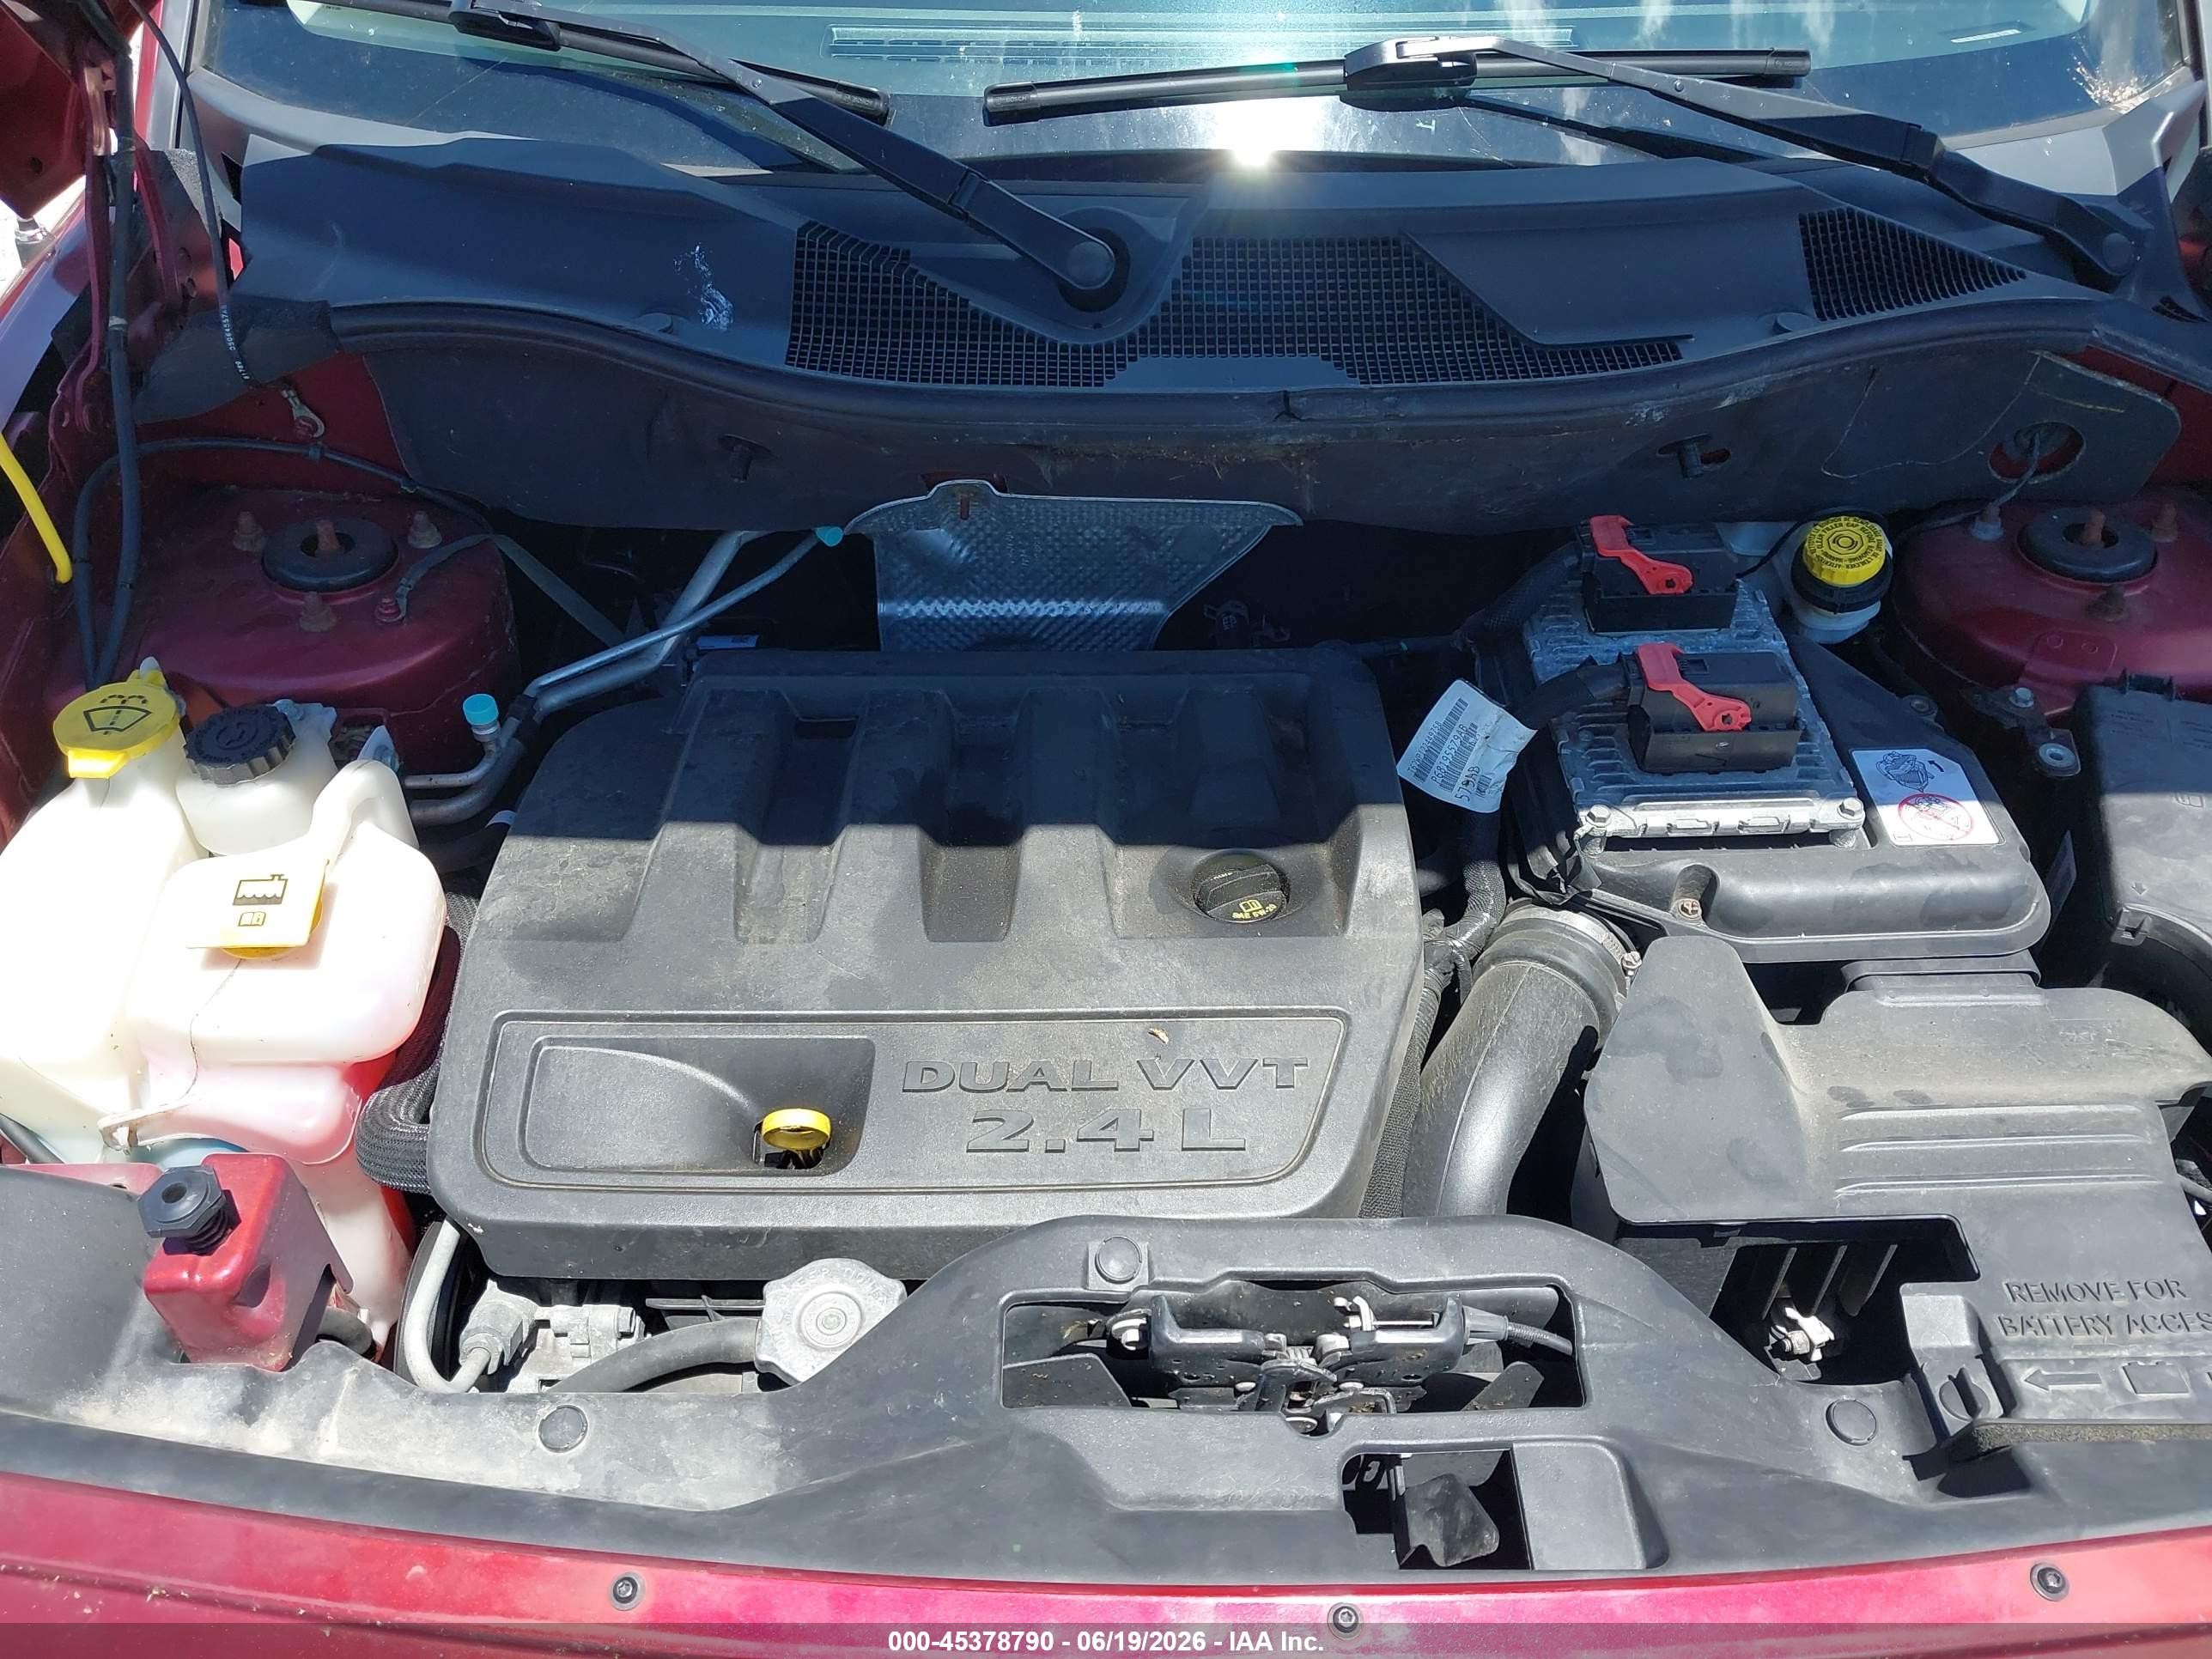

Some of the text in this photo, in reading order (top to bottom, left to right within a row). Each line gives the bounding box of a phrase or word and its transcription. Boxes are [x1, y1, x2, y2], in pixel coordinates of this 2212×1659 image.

[1821, 523, 1843, 534] FILLER
[1431, 723, 1468, 784] P68195579AB
[1455, 765, 1480, 802] 579AB
[1252, 903, 1278, 918] 5W-20
[902, 1056, 1309, 1094] DUAL VVT
[2002, 1278, 2190, 1304] REMOVE FOR
[1996, 1313, 2116, 1337] BATTERY
